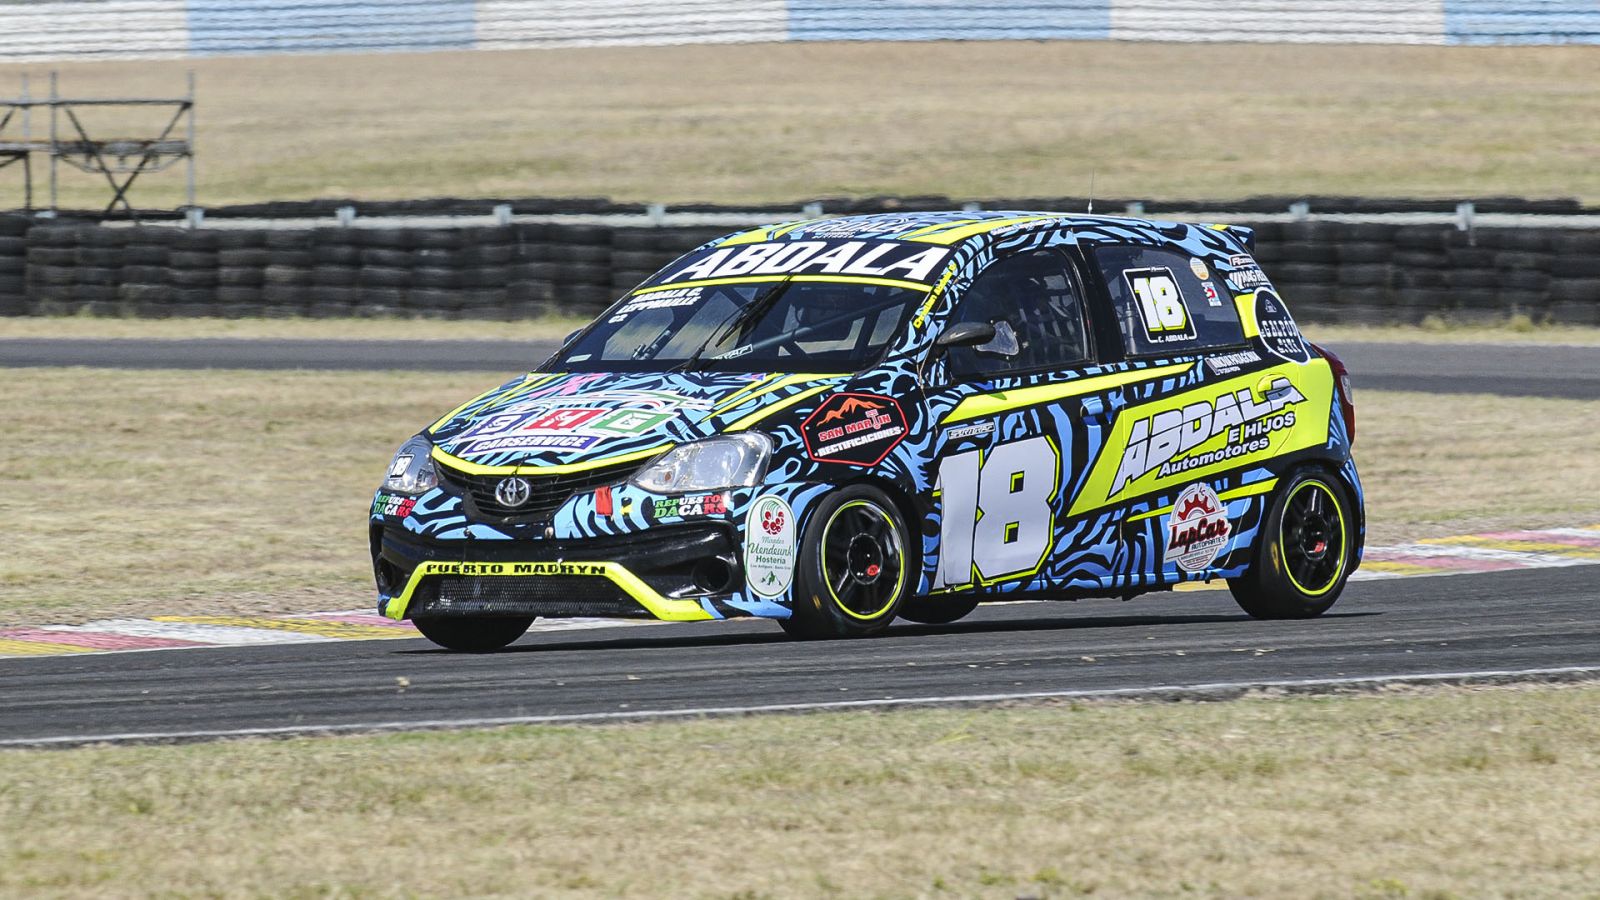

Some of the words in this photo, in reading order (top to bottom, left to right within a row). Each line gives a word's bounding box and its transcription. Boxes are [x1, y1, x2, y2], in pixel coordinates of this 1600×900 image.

[660, 241, 950, 284] ABDALA
[1134, 276, 1186, 331] 18
[817, 426, 902, 457] RECTIFICACIONES
[818, 427, 844, 441] SAN
[845, 409, 891, 434] MARTIN
[1109, 378, 1307, 499] ABDALA
[1229, 429, 1240, 442] E
[1245, 412, 1295, 439] HIJOS
[477, 435, 589, 451] CARSERVICE
[1158, 438, 1268, 477] Automotores
[932, 435, 1058, 590] 18
[1168, 517, 1228, 554] LapCar
[1191, 536, 1226, 550] AUTOPARTES
[426, 564, 503, 574] PUERTO
[513, 564, 606, 574] MADRYN
